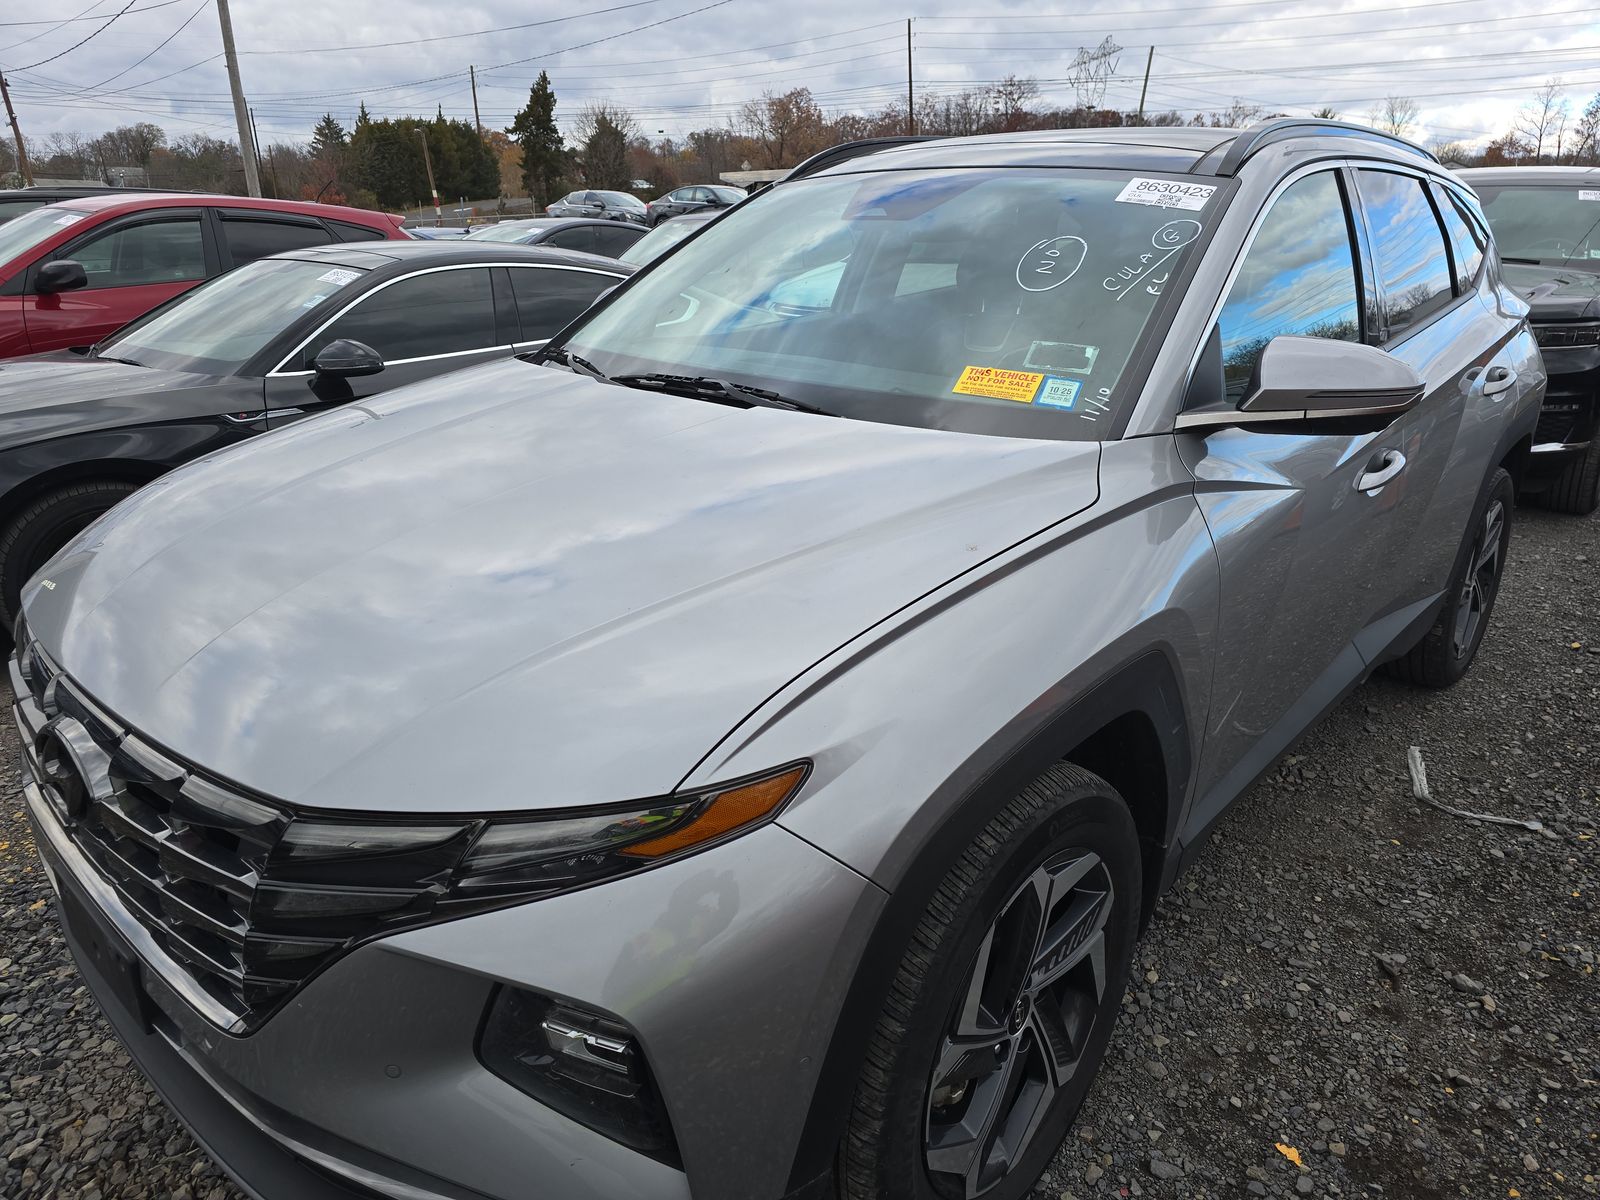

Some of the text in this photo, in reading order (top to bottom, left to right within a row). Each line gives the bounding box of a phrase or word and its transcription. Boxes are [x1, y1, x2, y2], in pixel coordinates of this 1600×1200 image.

[1136, 181, 1213, 198] 8630423
[969, 367, 1039, 383] THIS VEHICLE
[987, 377, 1006, 385] FOR
[1008, 380, 1033, 389] SALE
[1049, 386, 1059, 394] 10
